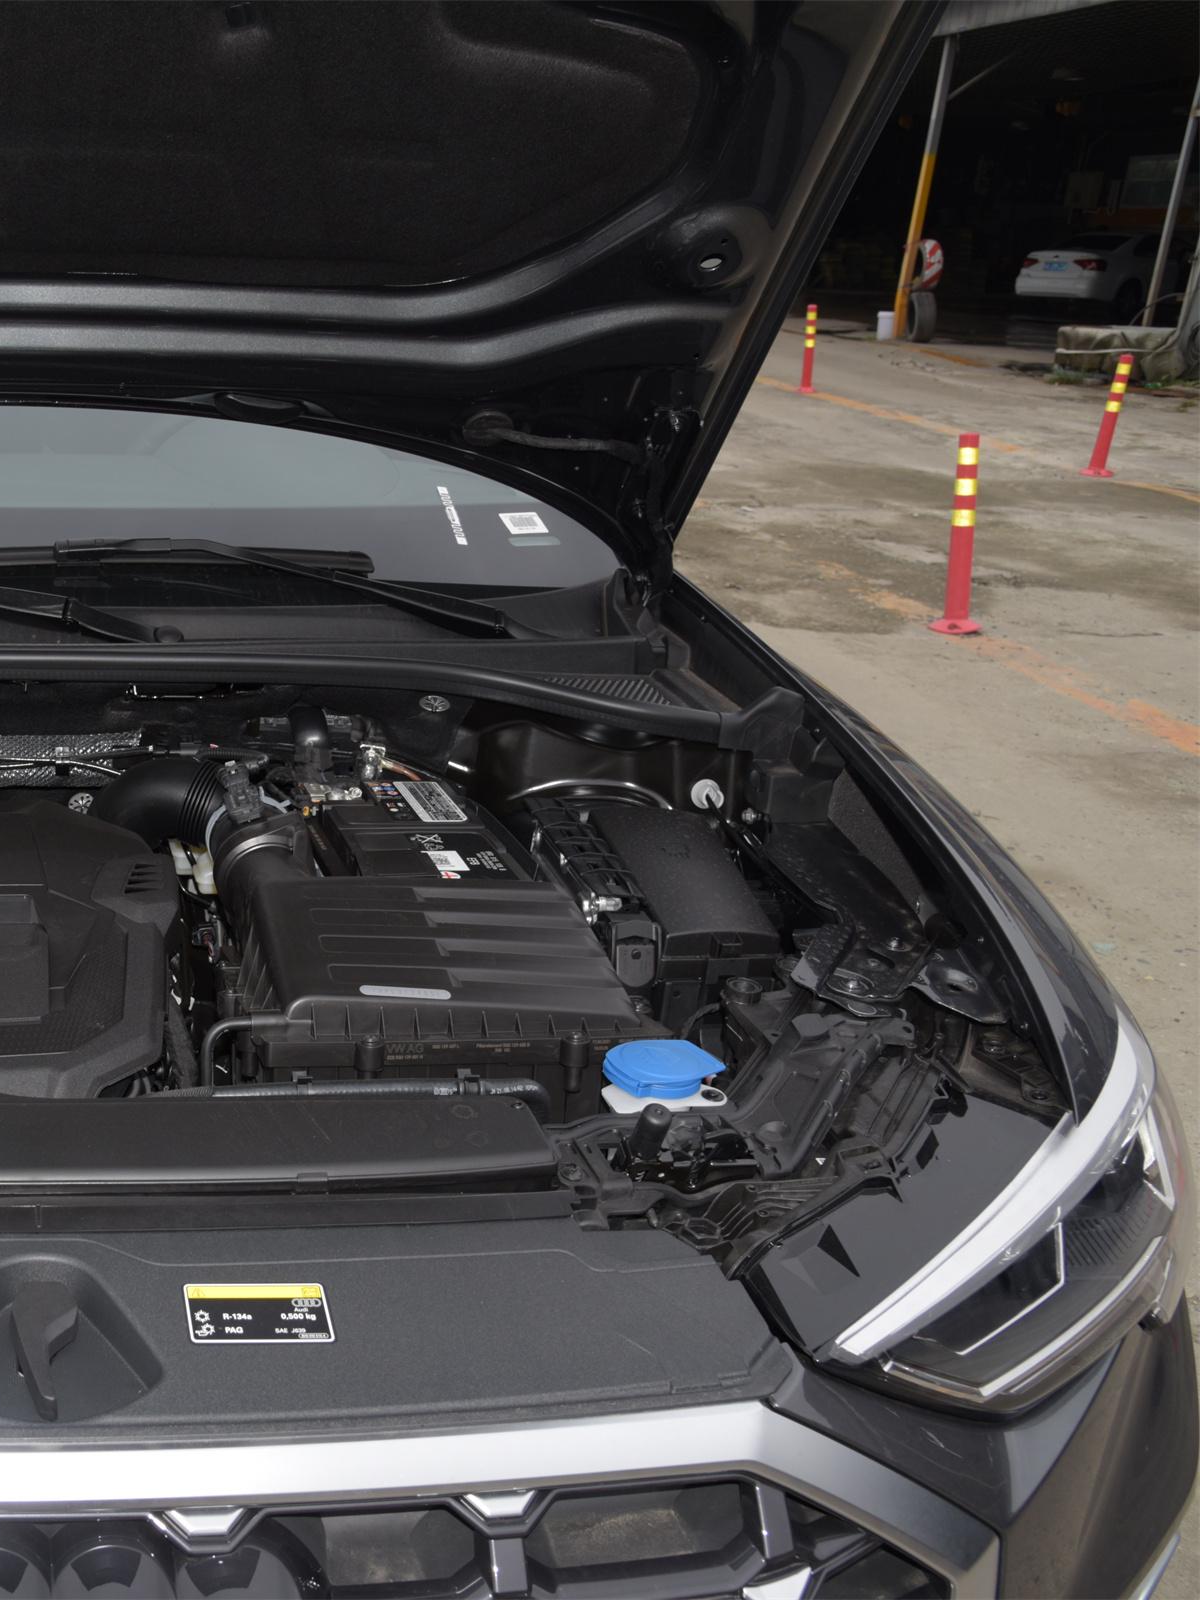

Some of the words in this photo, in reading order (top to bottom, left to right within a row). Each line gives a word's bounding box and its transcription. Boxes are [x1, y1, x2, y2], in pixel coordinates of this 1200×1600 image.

[386, 1043, 406, 1053] VW
[407, 1043, 423, 1053] AG
[305, 1313, 317, 1321] kg
